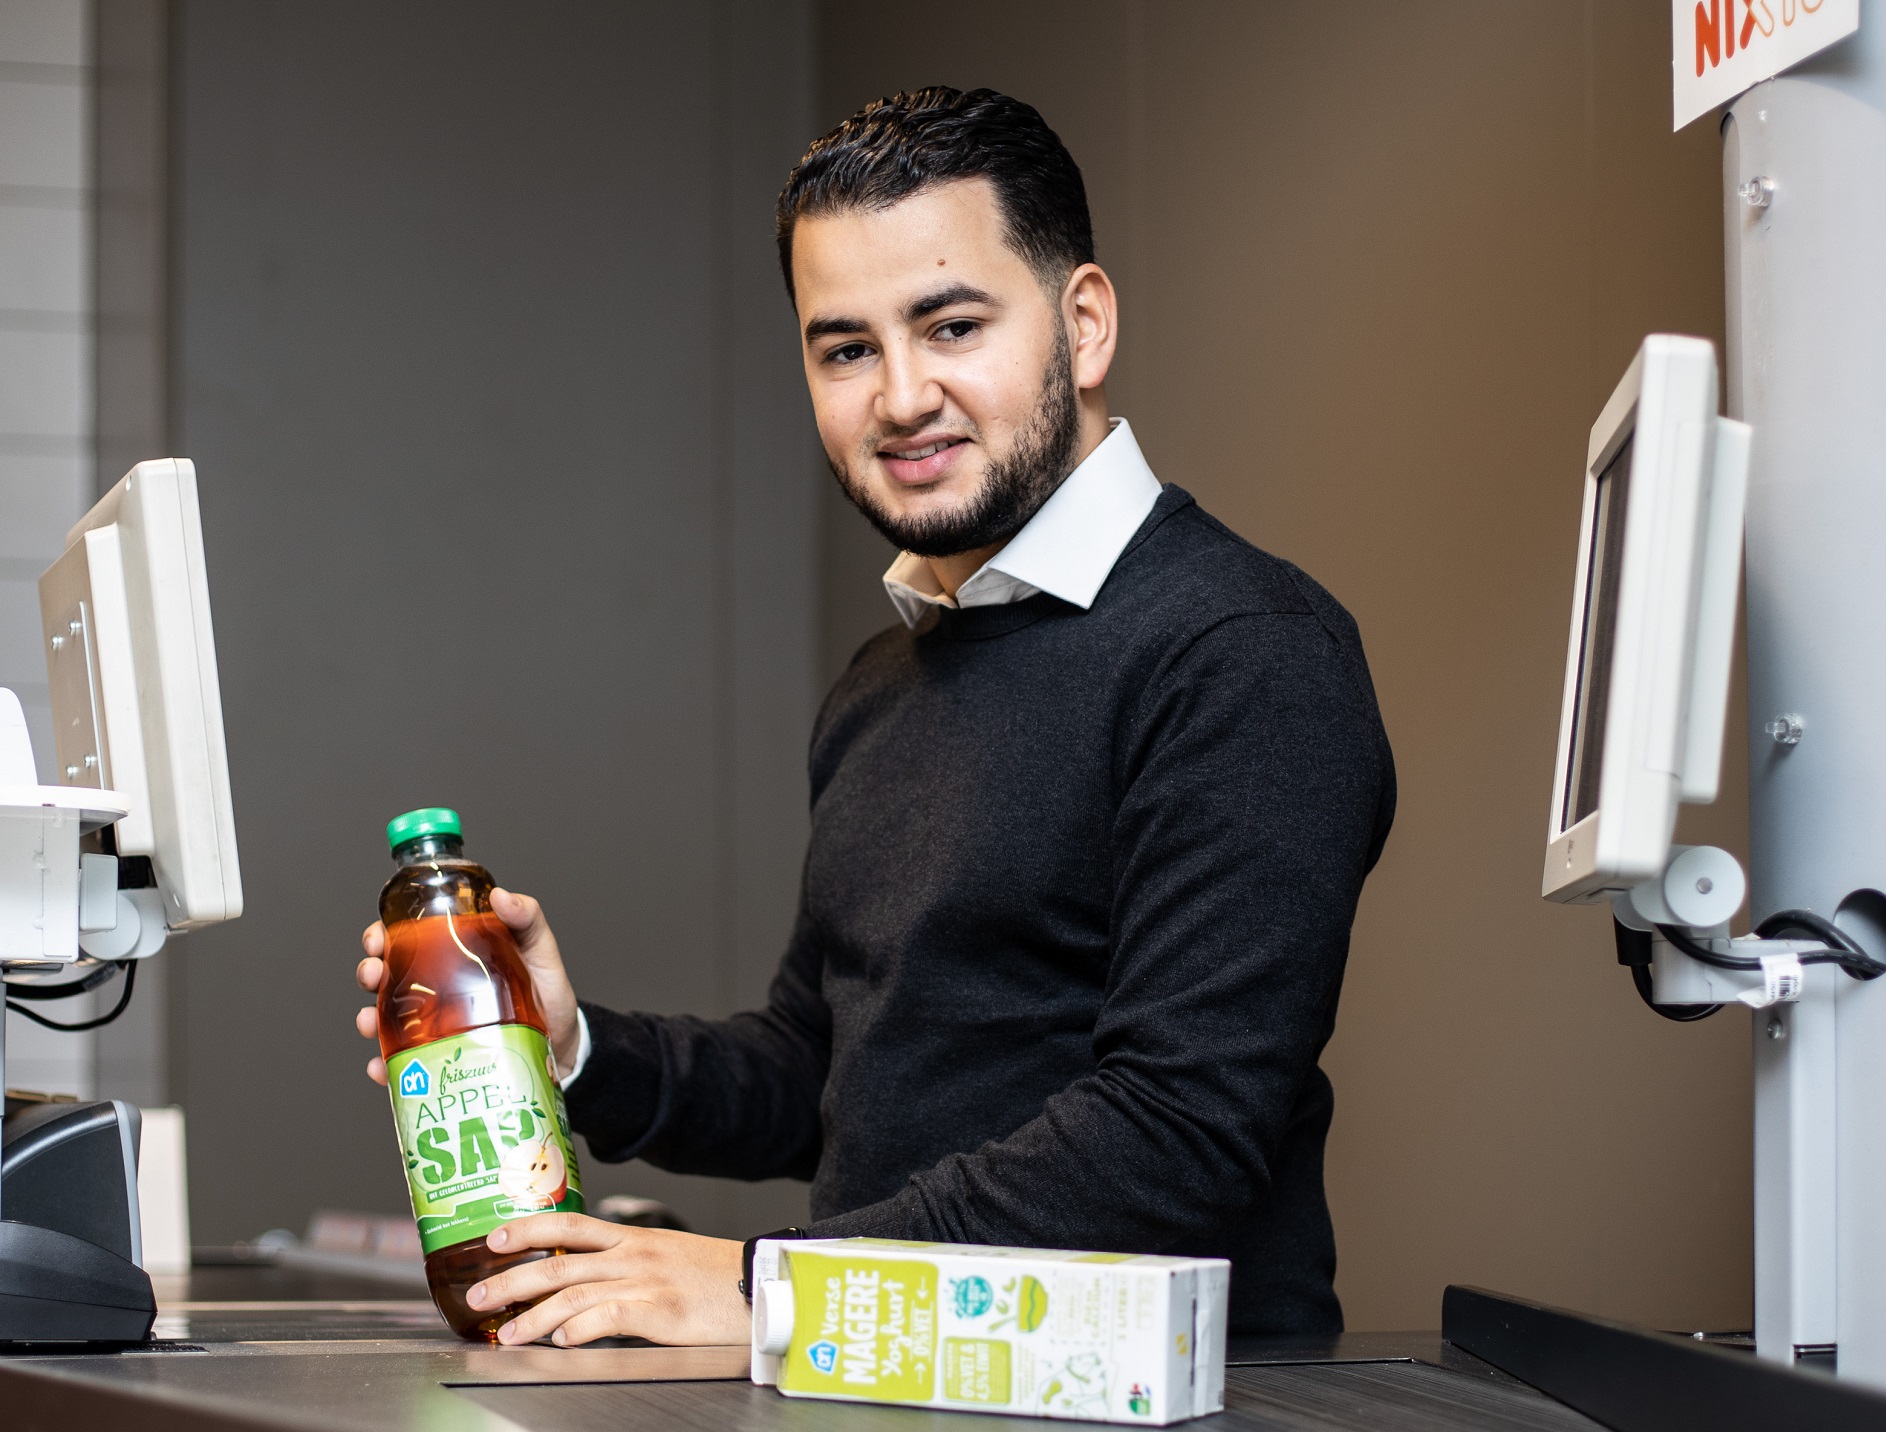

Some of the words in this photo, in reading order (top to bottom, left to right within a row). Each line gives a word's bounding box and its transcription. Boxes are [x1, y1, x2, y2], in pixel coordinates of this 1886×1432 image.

[416, 1108, 536, 1185] SAP
[819, 1276, 842, 1336] Verse
[843, 1268, 880, 1385] MAGERE
[879, 1278, 913, 1377] Yoghurt
